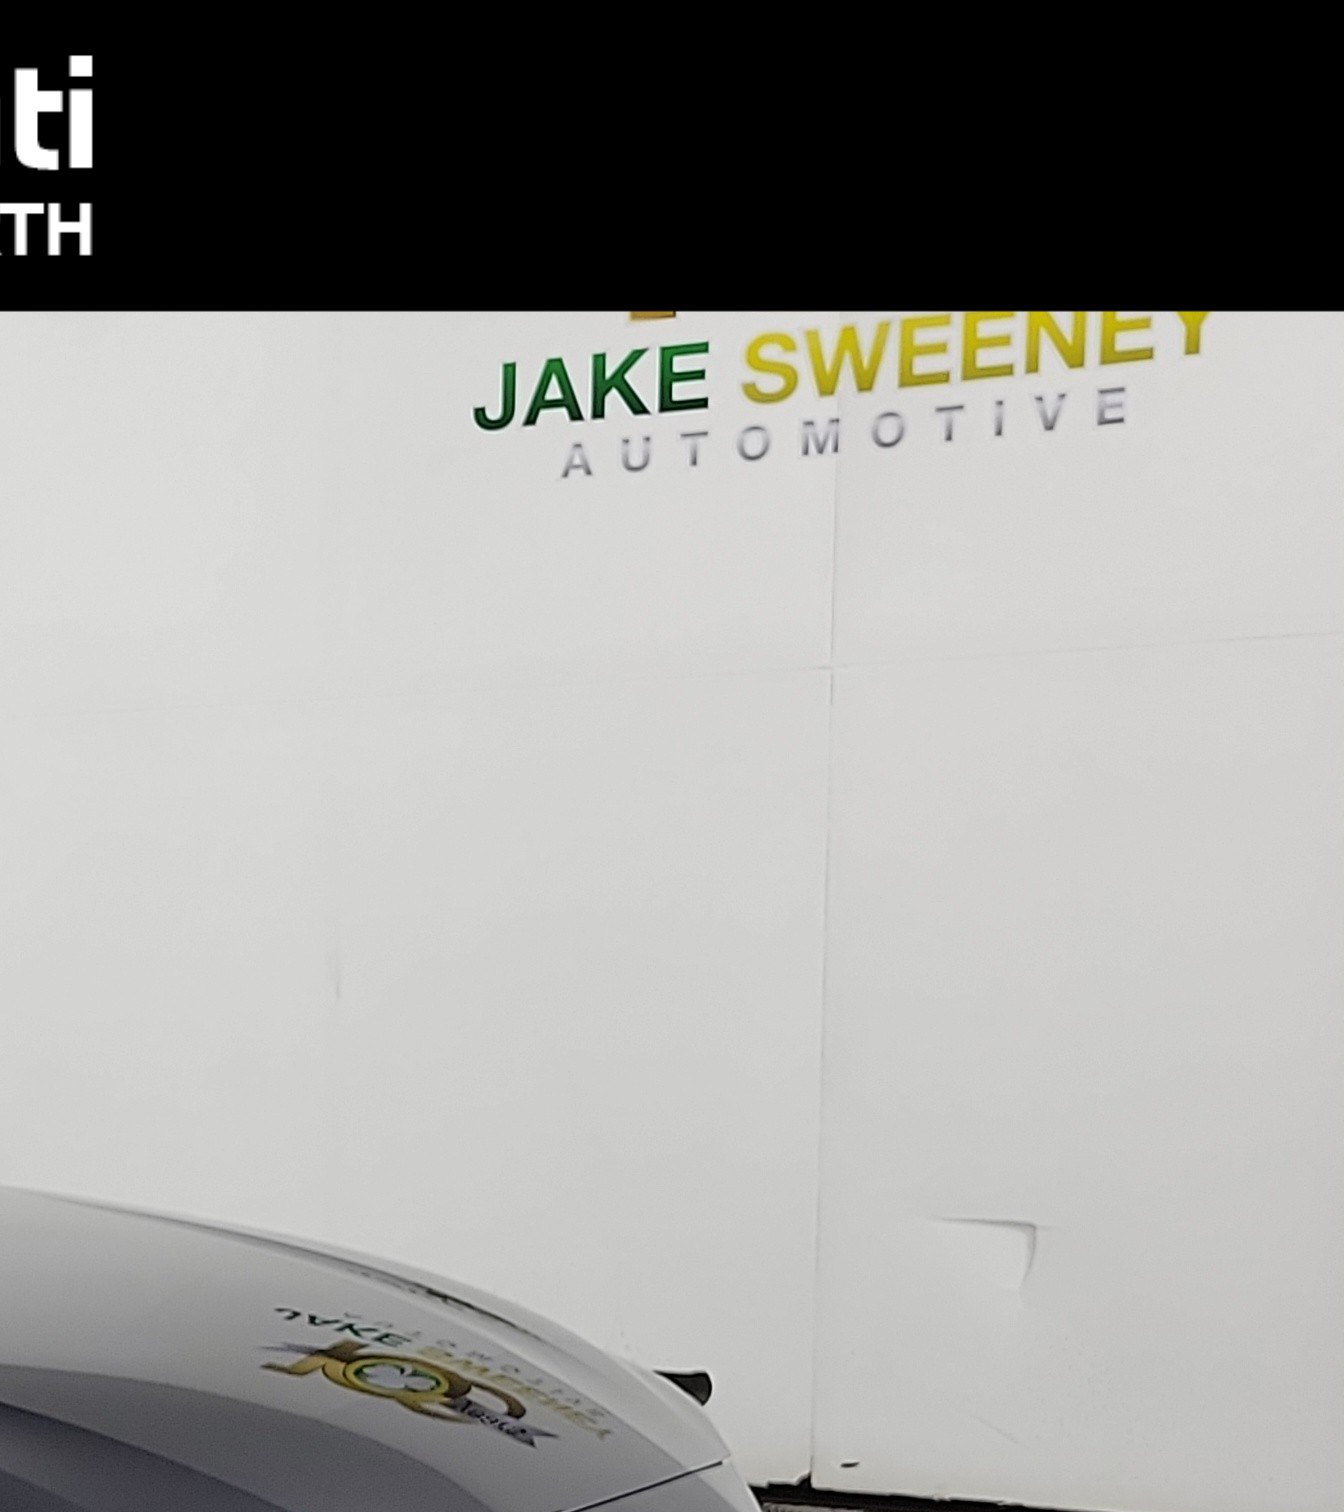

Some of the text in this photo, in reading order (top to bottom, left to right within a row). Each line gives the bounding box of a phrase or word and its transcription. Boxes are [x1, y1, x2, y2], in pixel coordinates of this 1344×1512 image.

[472, 311, 1213, 431] JAKE SWEENEY
[560, 387, 1127, 479] AUTOMOTIVE
